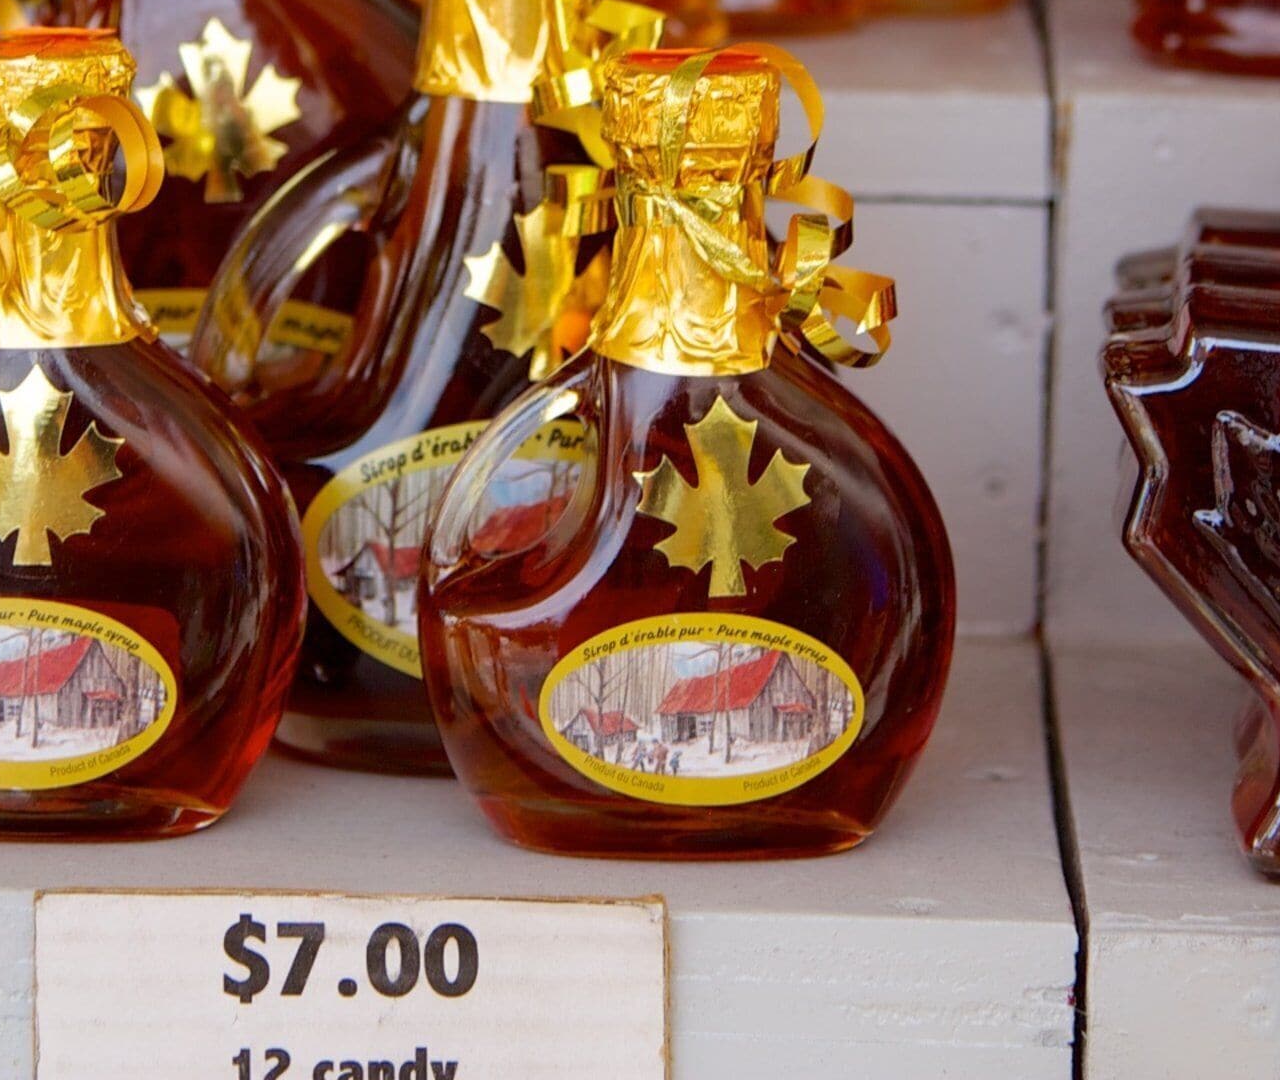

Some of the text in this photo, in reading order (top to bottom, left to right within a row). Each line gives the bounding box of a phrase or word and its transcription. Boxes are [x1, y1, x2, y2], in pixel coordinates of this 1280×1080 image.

[360, 449, 407, 483] Sirop
[26, 609, 60, 624] Pure
[61, 614, 105, 635] maple
[104, 627, 141, 652] syrup
[582, 624, 829, 664] Sirop d'érable pur Pure maple syrup
[49, 744, 132, 778] Product of Canada
[742, 756, 823, 792] Product of Canada
[630, 775, 665, 794] Canada
[222, 914, 480, 1004] $7.00
[232, 1047, 291, 1080] 12
